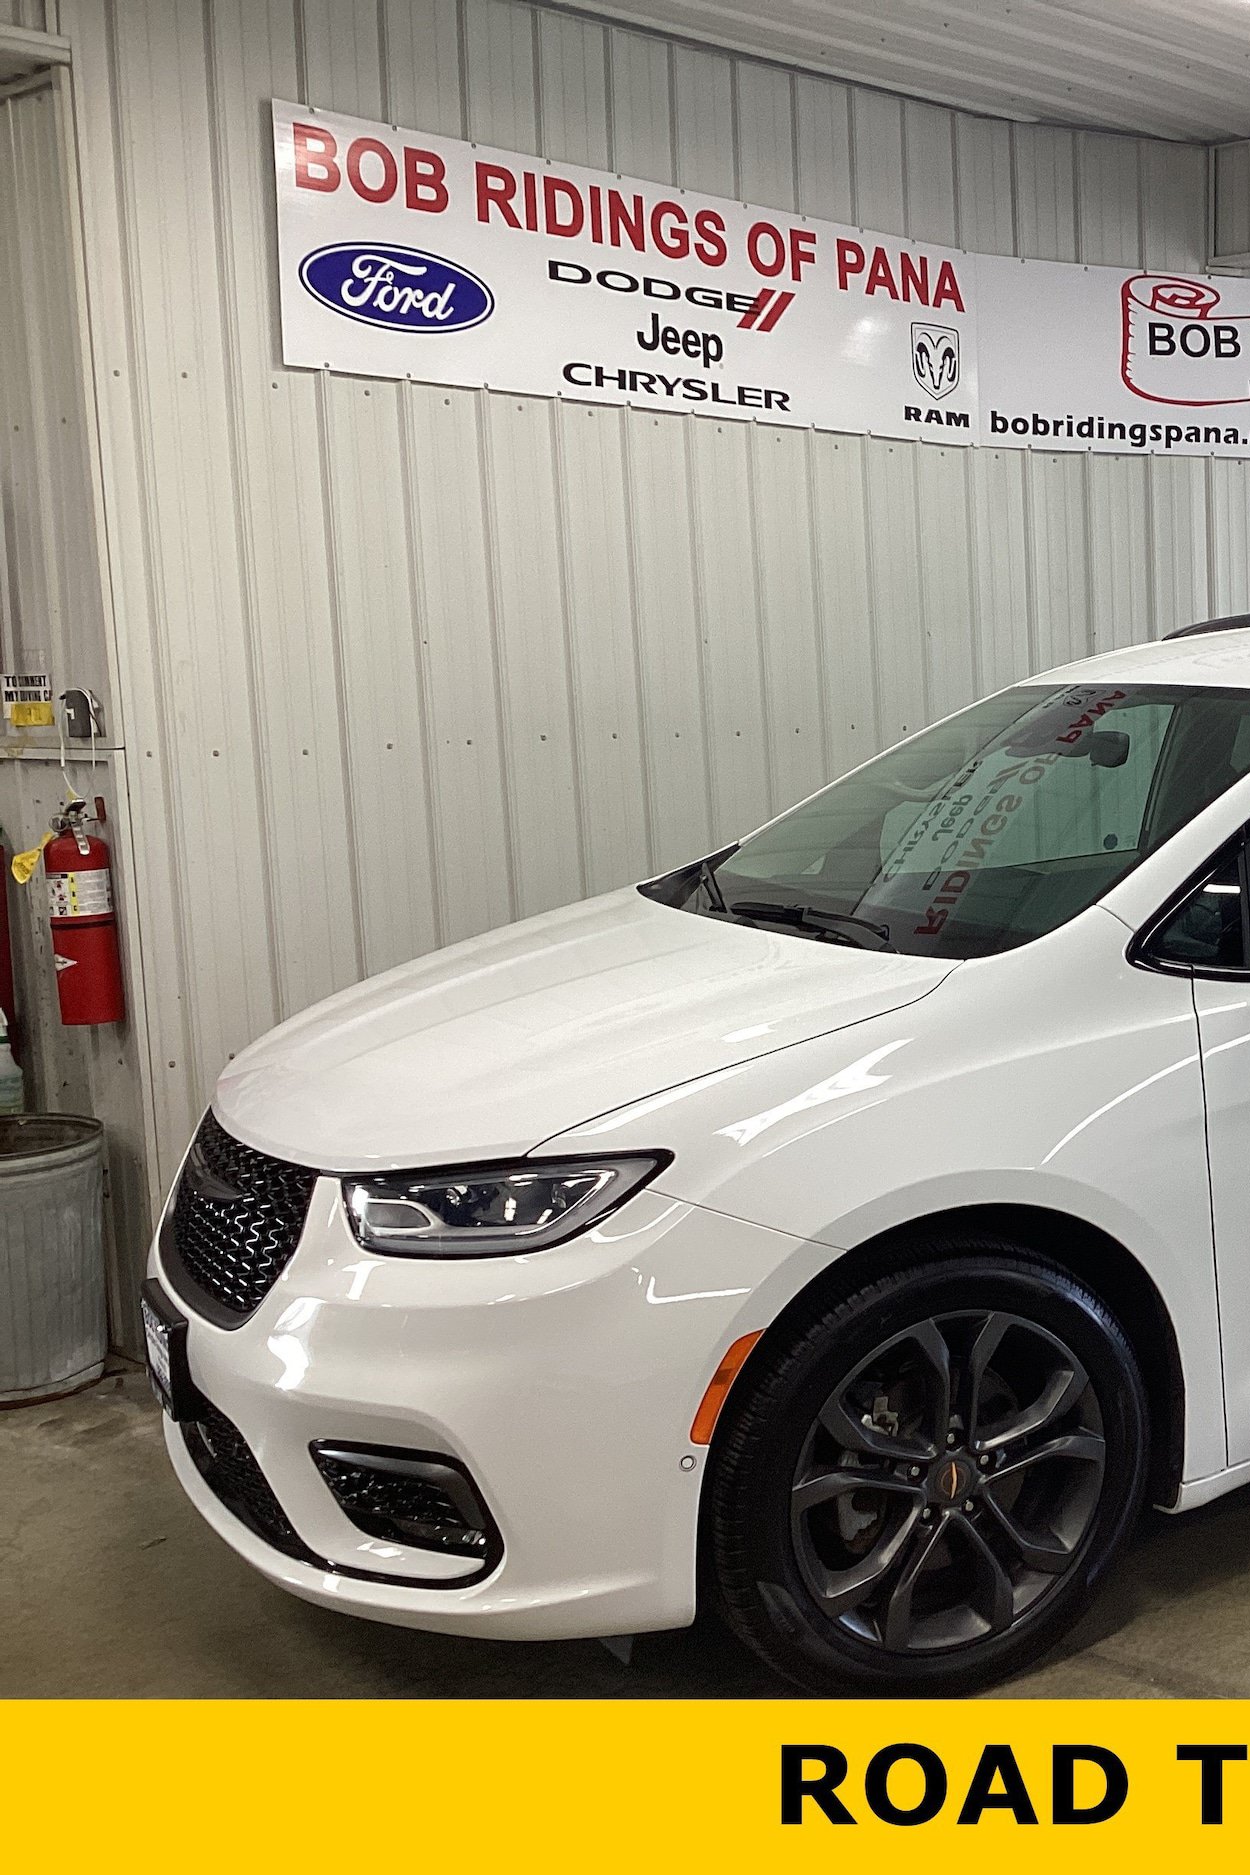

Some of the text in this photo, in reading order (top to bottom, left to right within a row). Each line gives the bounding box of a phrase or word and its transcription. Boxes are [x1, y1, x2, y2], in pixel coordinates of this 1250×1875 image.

[292, 121, 966, 313] BOB RIDINGS OF PANA
[340, 254, 456, 320] Ford
[547, 259, 762, 316] DODGE
[636, 312, 724, 369] Jeep
[1148, 321, 1242, 359] BOB
[562, 362, 793, 412] CHRYSLER
[903, 405, 970, 429] RAM
